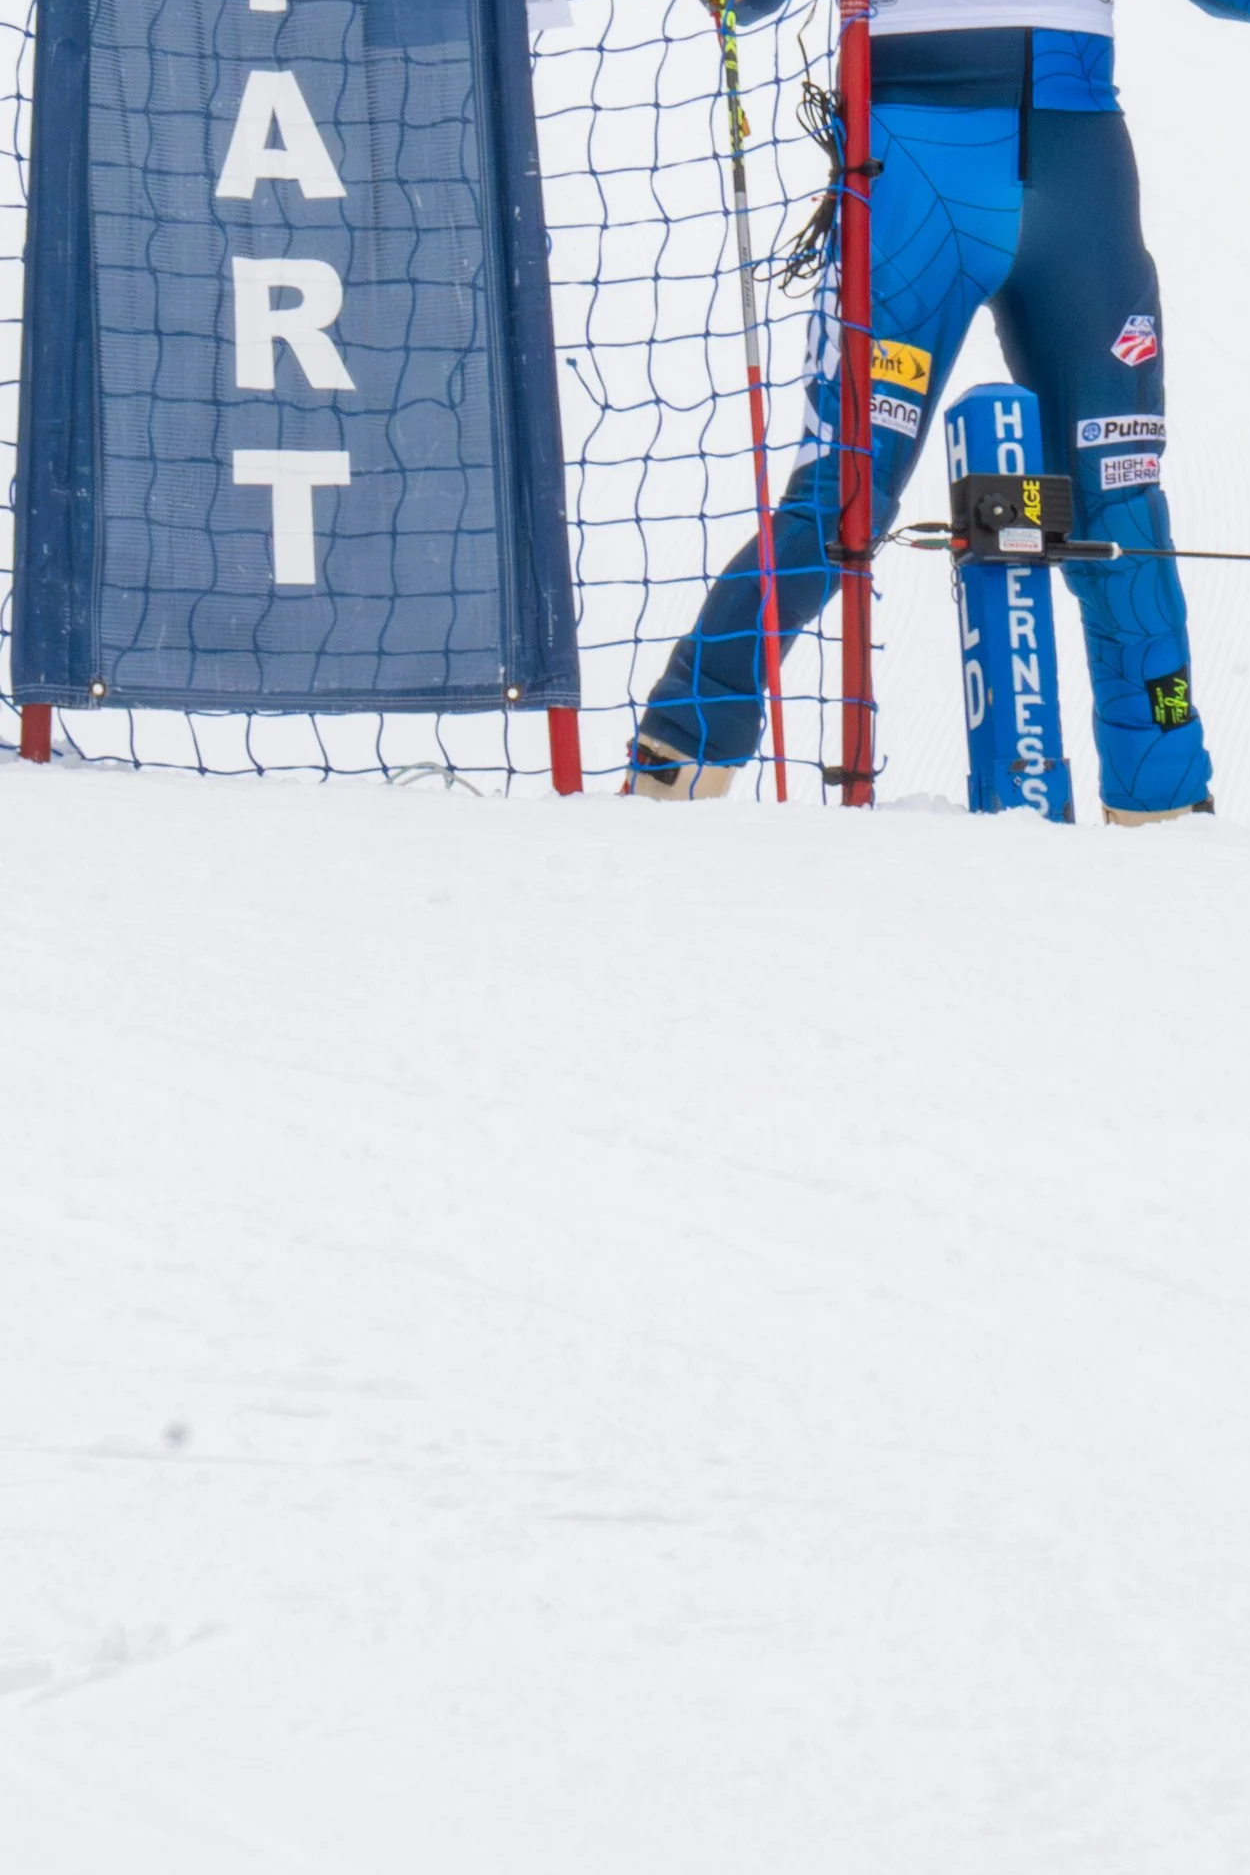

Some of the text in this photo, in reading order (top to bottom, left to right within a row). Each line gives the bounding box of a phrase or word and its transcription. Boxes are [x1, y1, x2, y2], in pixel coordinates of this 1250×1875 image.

[1022, 478, 1042, 525] ALGE
[1104, 458, 1143, 473] HIGH
[950, 416, 986, 731] HLD
[993, 400, 1050, 817] HOERNESS
